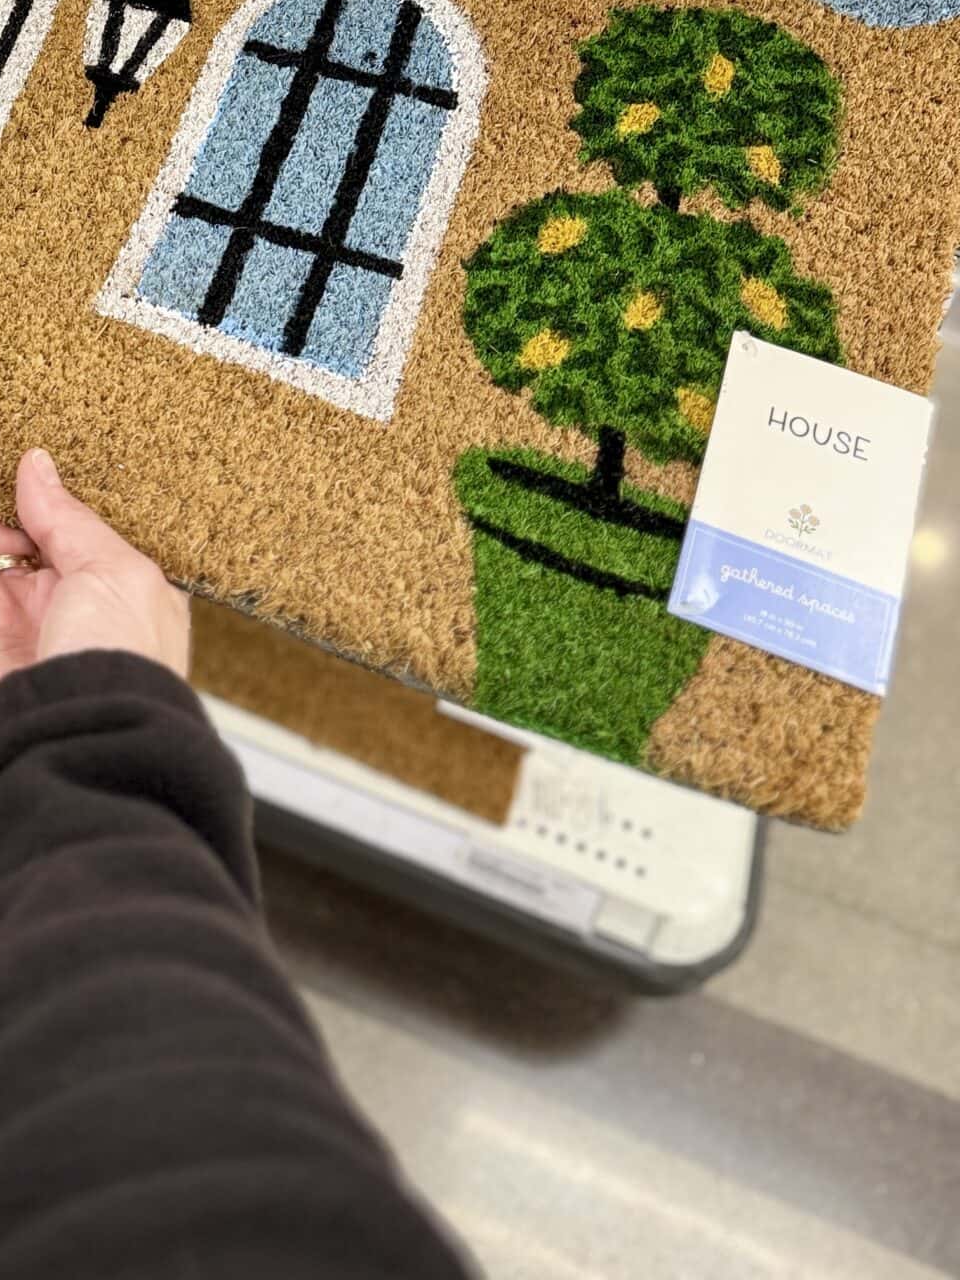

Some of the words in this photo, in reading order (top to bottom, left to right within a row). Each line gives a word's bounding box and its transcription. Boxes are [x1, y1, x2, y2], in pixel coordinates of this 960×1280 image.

[767, 405, 871, 462] HOUSE
[764, 527, 835, 561] DOORMAT
[720, 562, 794, 603] gathered
[797, 589, 856, 625] spaces
